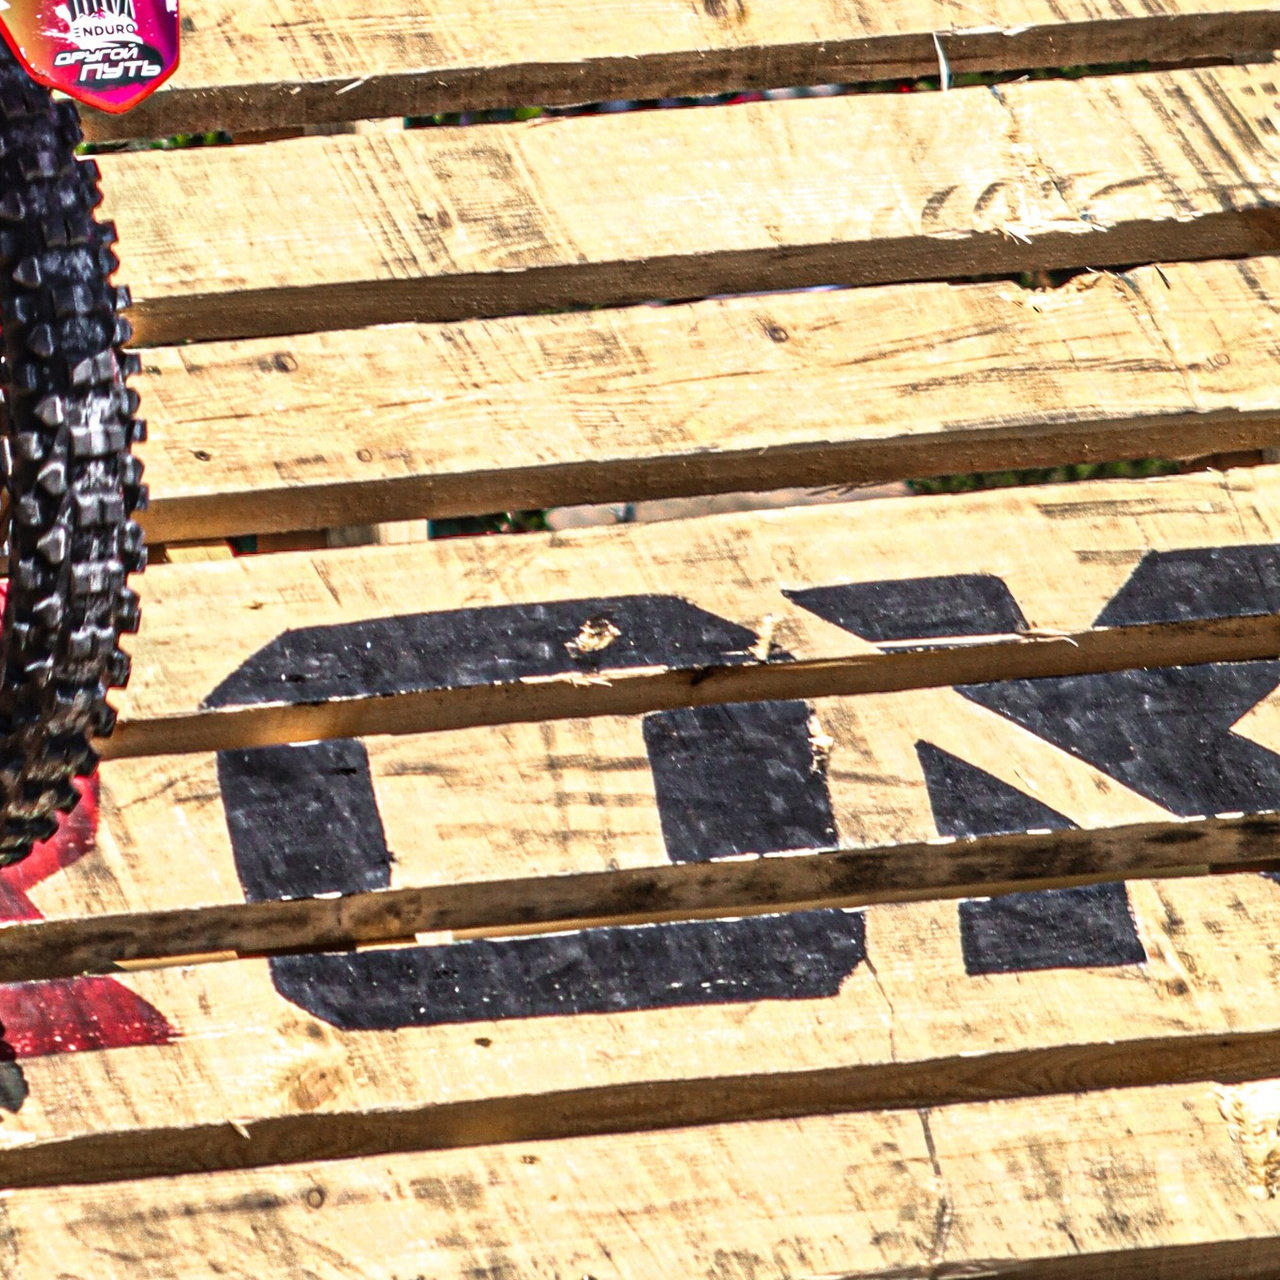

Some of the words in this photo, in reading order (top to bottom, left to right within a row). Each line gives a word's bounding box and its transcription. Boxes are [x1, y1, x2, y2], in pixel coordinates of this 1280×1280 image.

[73, 23, 135, 38] ENDURO
[53, 42, 138, 66] ДРУГОЙ
[79, 59, 161, 82] ПУТЬ
